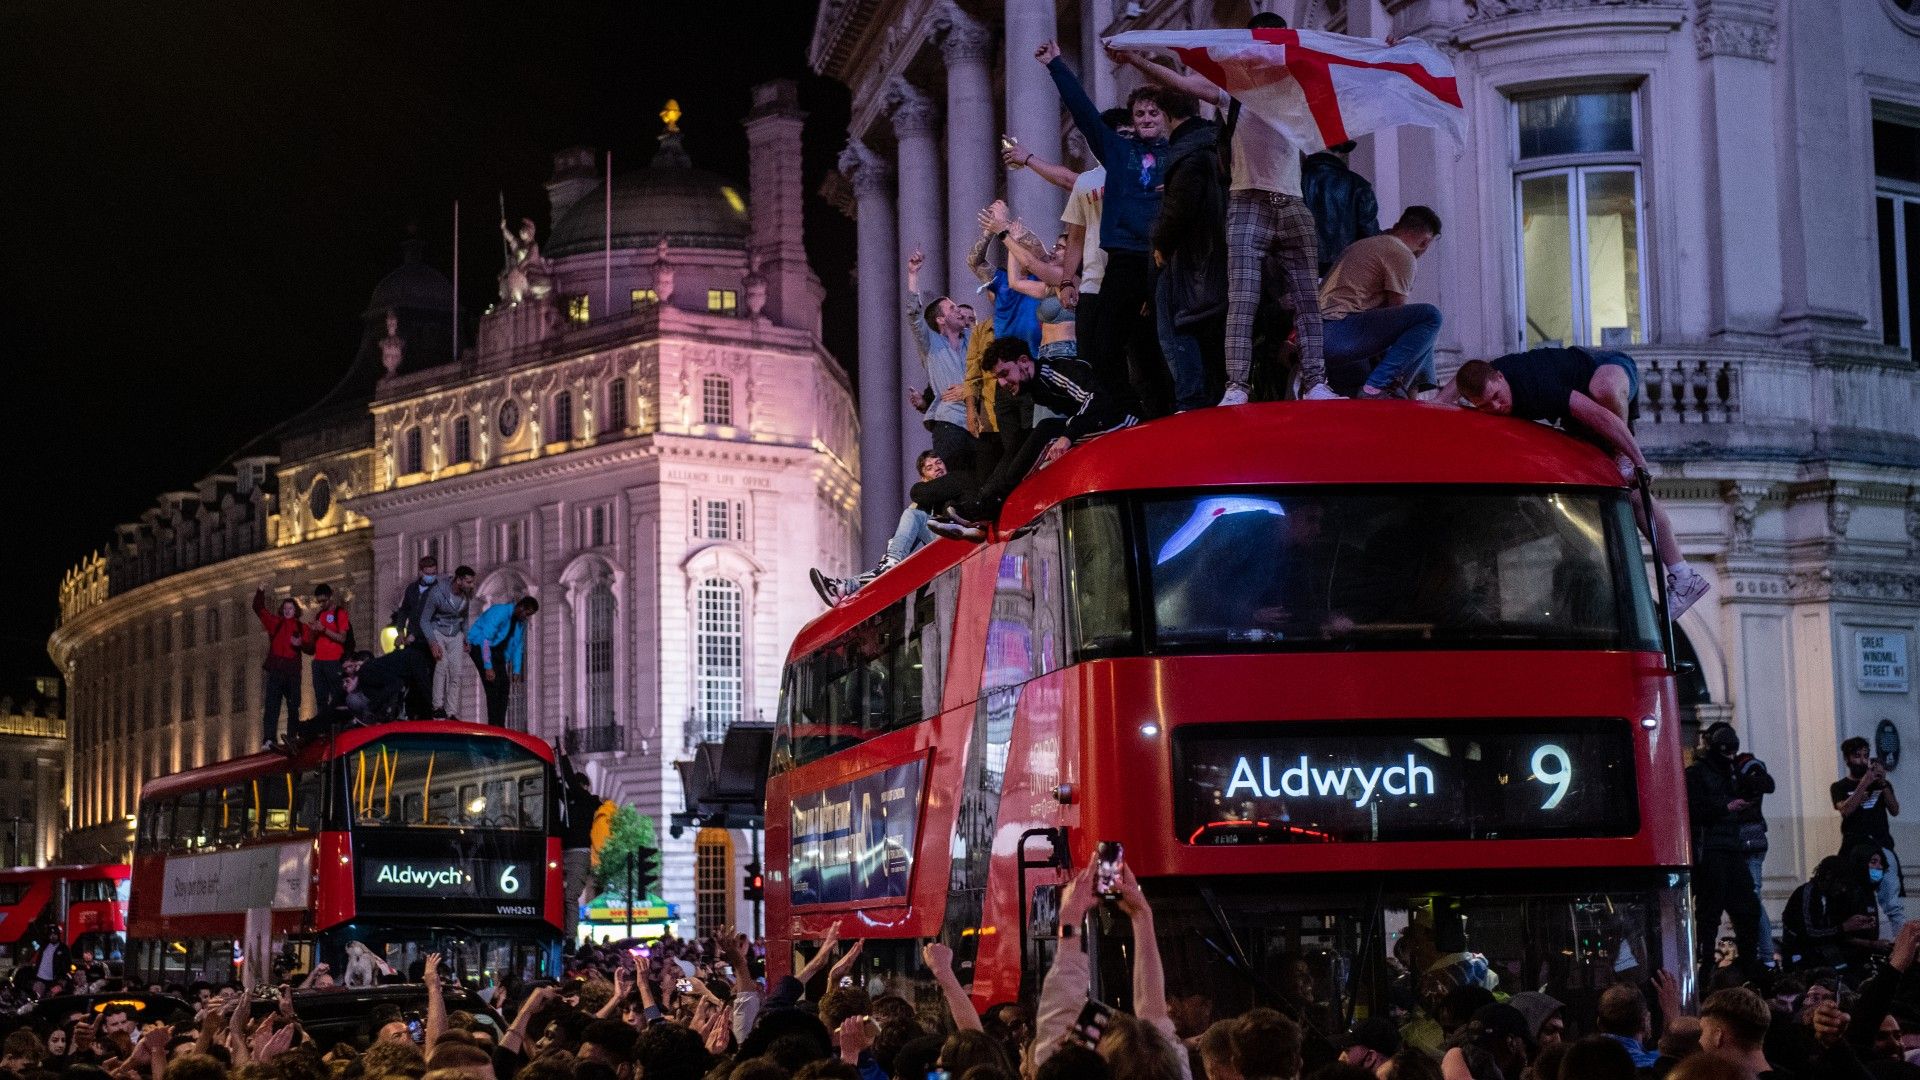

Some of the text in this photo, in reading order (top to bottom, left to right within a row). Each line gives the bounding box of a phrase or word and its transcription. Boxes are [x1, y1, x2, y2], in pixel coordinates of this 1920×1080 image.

[668, 470, 770, 488] ALLIANCE LIFE OFFICE
[1861, 636, 1884, 648] GREAT
[1863, 651, 1898, 663] WINDMILL
[1863, 664, 1904, 677] STREET W1
[1030, 735, 1060, 766] LONDON
[1030, 767, 1060, 797] UNITED
[1225, 744, 1572, 810] Aldwych 9
[376, 864, 519, 894] Aldwych 6
[496, 905, 536, 915] VWH2431
